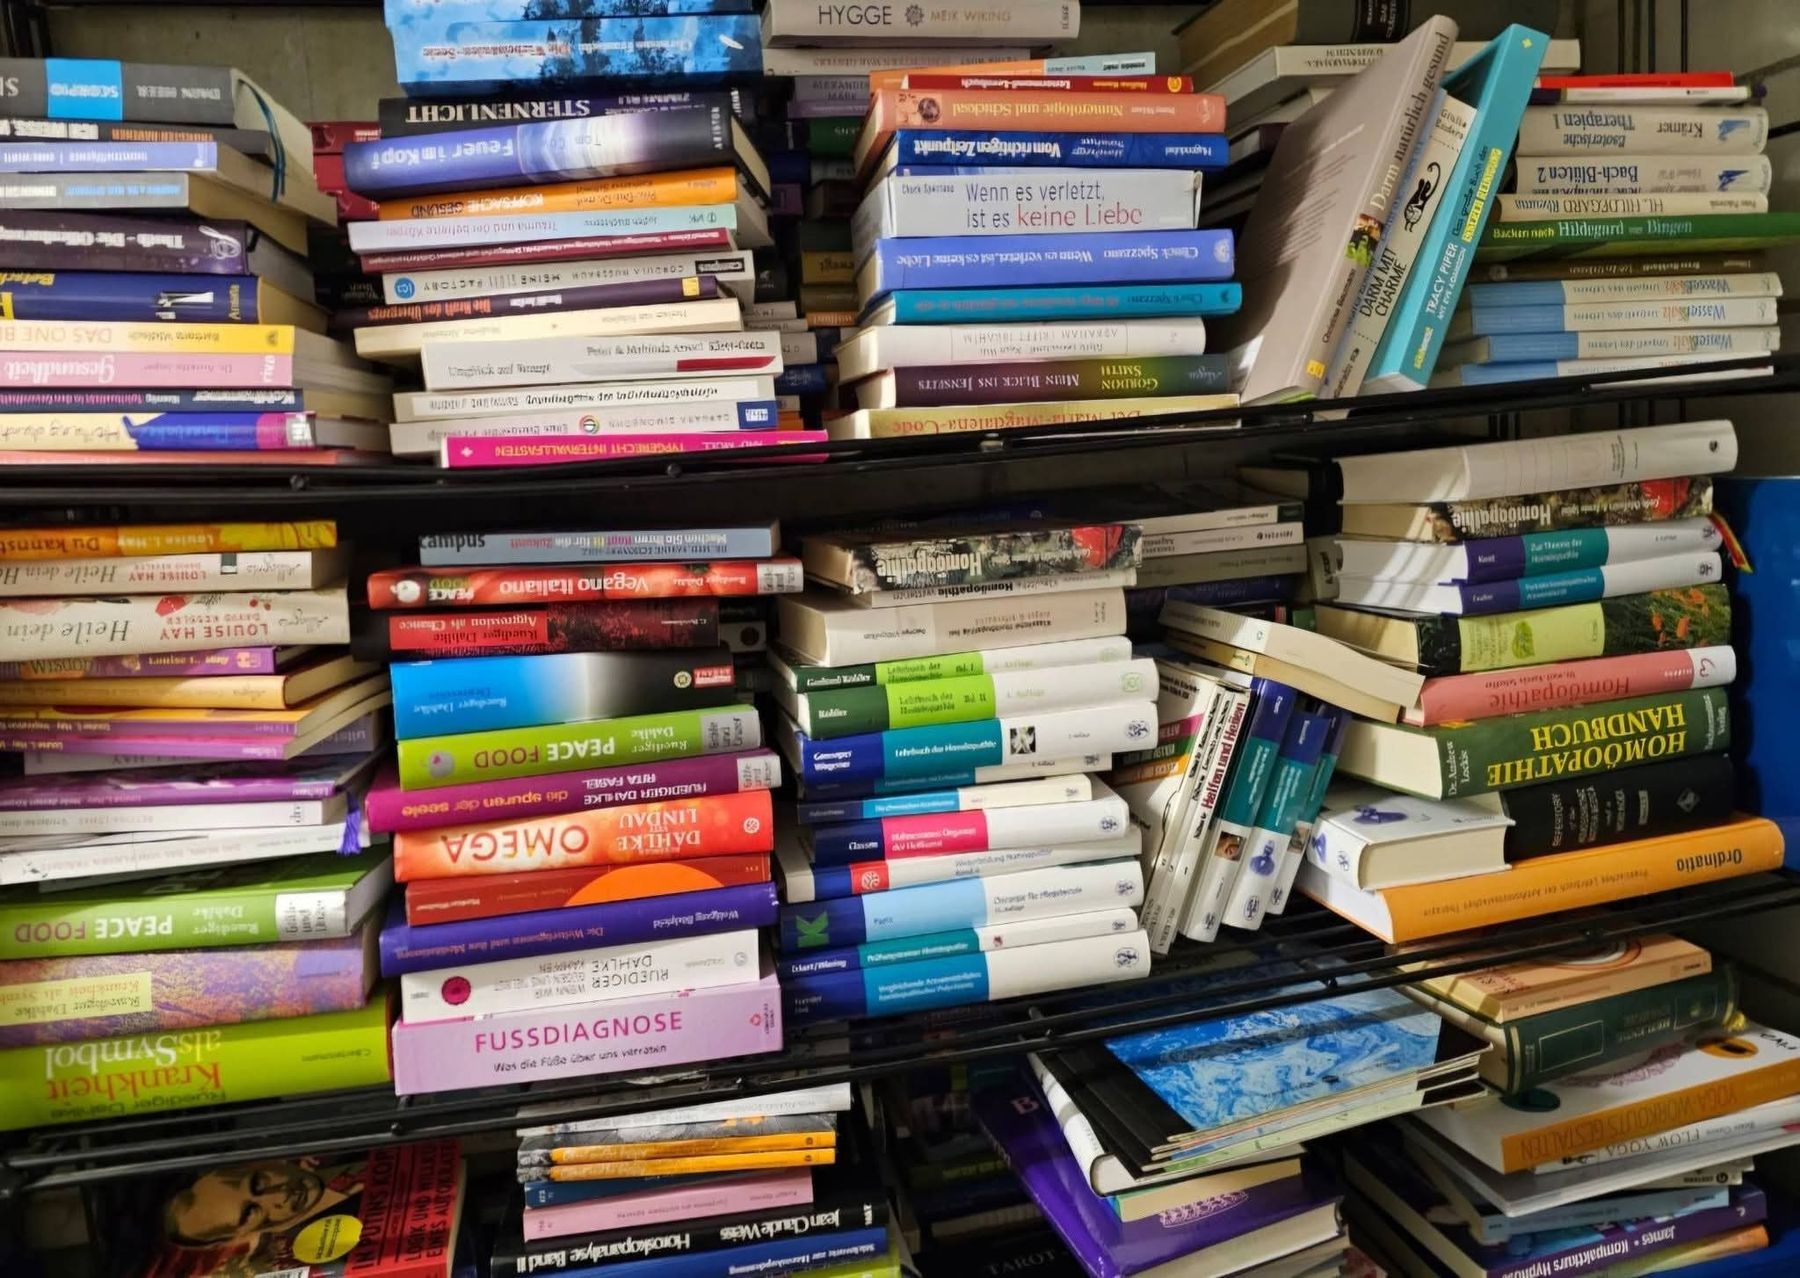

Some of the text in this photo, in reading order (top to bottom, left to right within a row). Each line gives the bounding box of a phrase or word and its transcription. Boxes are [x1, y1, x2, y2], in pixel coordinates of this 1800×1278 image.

[818, 5, 893, 26] HYGGE
[930, 10, 962, 22] MEIK
[405, 100, 591, 123] STERNENLICHT
[1042, 100, 1124, 117] Numerologie
[1368, 31, 1452, 213] Darm natürlich gesund
[1563, 113, 1636, 132] Therapien
[1656, 122, 1703, 139] Krämer
[452, 139, 514, 164] Feuer
[913, 138, 976, 159] Zeitpunkt
[1034, 141, 1062, 159] Vom
[1563, 134, 1626, 149] Esoterische
[369, 146, 420, 170] Kopf
[1536, 165, 1638, 183] Bach-Blüten 2
[966, 180, 1106, 202] Wenn es verletzt,
[967, 202, 1143, 228] ist es keine Liebe
[1563, 198, 1641, 213] HILDEGARD
[1359, 247, 1397, 318] DARM MIT
[1425, 242, 1458, 314] TRACY PIPER
[1374, 262, 1408, 317] CHARME
[4, 354, 116, 385] Gesundheit
[1100, 364, 1142, 379] SMITH
[1101, 376, 1158, 391] GORDON
[1451, 502, 1552, 537] Homöopathie
[70, 535, 100, 553] Du
[25, 563, 119, 583] Heile dein
[499, 571, 650, 596] Vegano Italiano
[937, 581, 1014, 598] Homöopathie
[7, 619, 131, 645] Heile dein
[158, 622, 269, 641] LOUISE HAY
[399, 619, 447, 632] Chance
[450, 618, 467, 630] als
[1488, 677, 1631, 710] Homöopathie
[630, 725, 675, 739] Dahlke
[1529, 702, 1686, 751] HANDBUCH
[473, 737, 616, 769] PEACE FOOD
[630, 739, 688, 754] Ruediger
[1486, 730, 1688, 786] HOMÖOPATHIE
[1199, 765, 1225, 810] Helfen
[1213, 740, 1233, 768] und
[401, 801, 450, 818] seele
[455, 799, 479, 813] der
[482, 790, 543, 809] spuren
[619, 808, 698, 829] LINDAU
[439, 825, 590, 864] OMEGA
[615, 830, 701, 851] DAHLKE
[1675, 847, 1743, 873] Ordinatio
[192, 905, 244, 919] Dahlke
[14, 914, 174, 944] PEACE FOOD
[191, 920, 259, 937] Ruediger
[591, 954, 653, 973] DAHLKE
[591, 967, 670, 989] RUEDIGER
[15, 1003, 66, 1020] Dahlke
[474, 1010, 683, 1053] FUSSDIAGNOSE
[44, 1028, 222, 1079] als Symbol
[493, 1061, 518, 1073] Was
[45, 1062, 223, 1104] Krankheit
[1606, 1129, 1700, 1158] FLOW YOGA
[720, 1217, 761, 1240] Weiss
[760, 1212, 810, 1235] Claude
[809, 1207, 841, 1230] Jean
[1641, 1225, 1677, 1248] James
[528, 1233, 691, 1271] Horoskopanalyse Band
